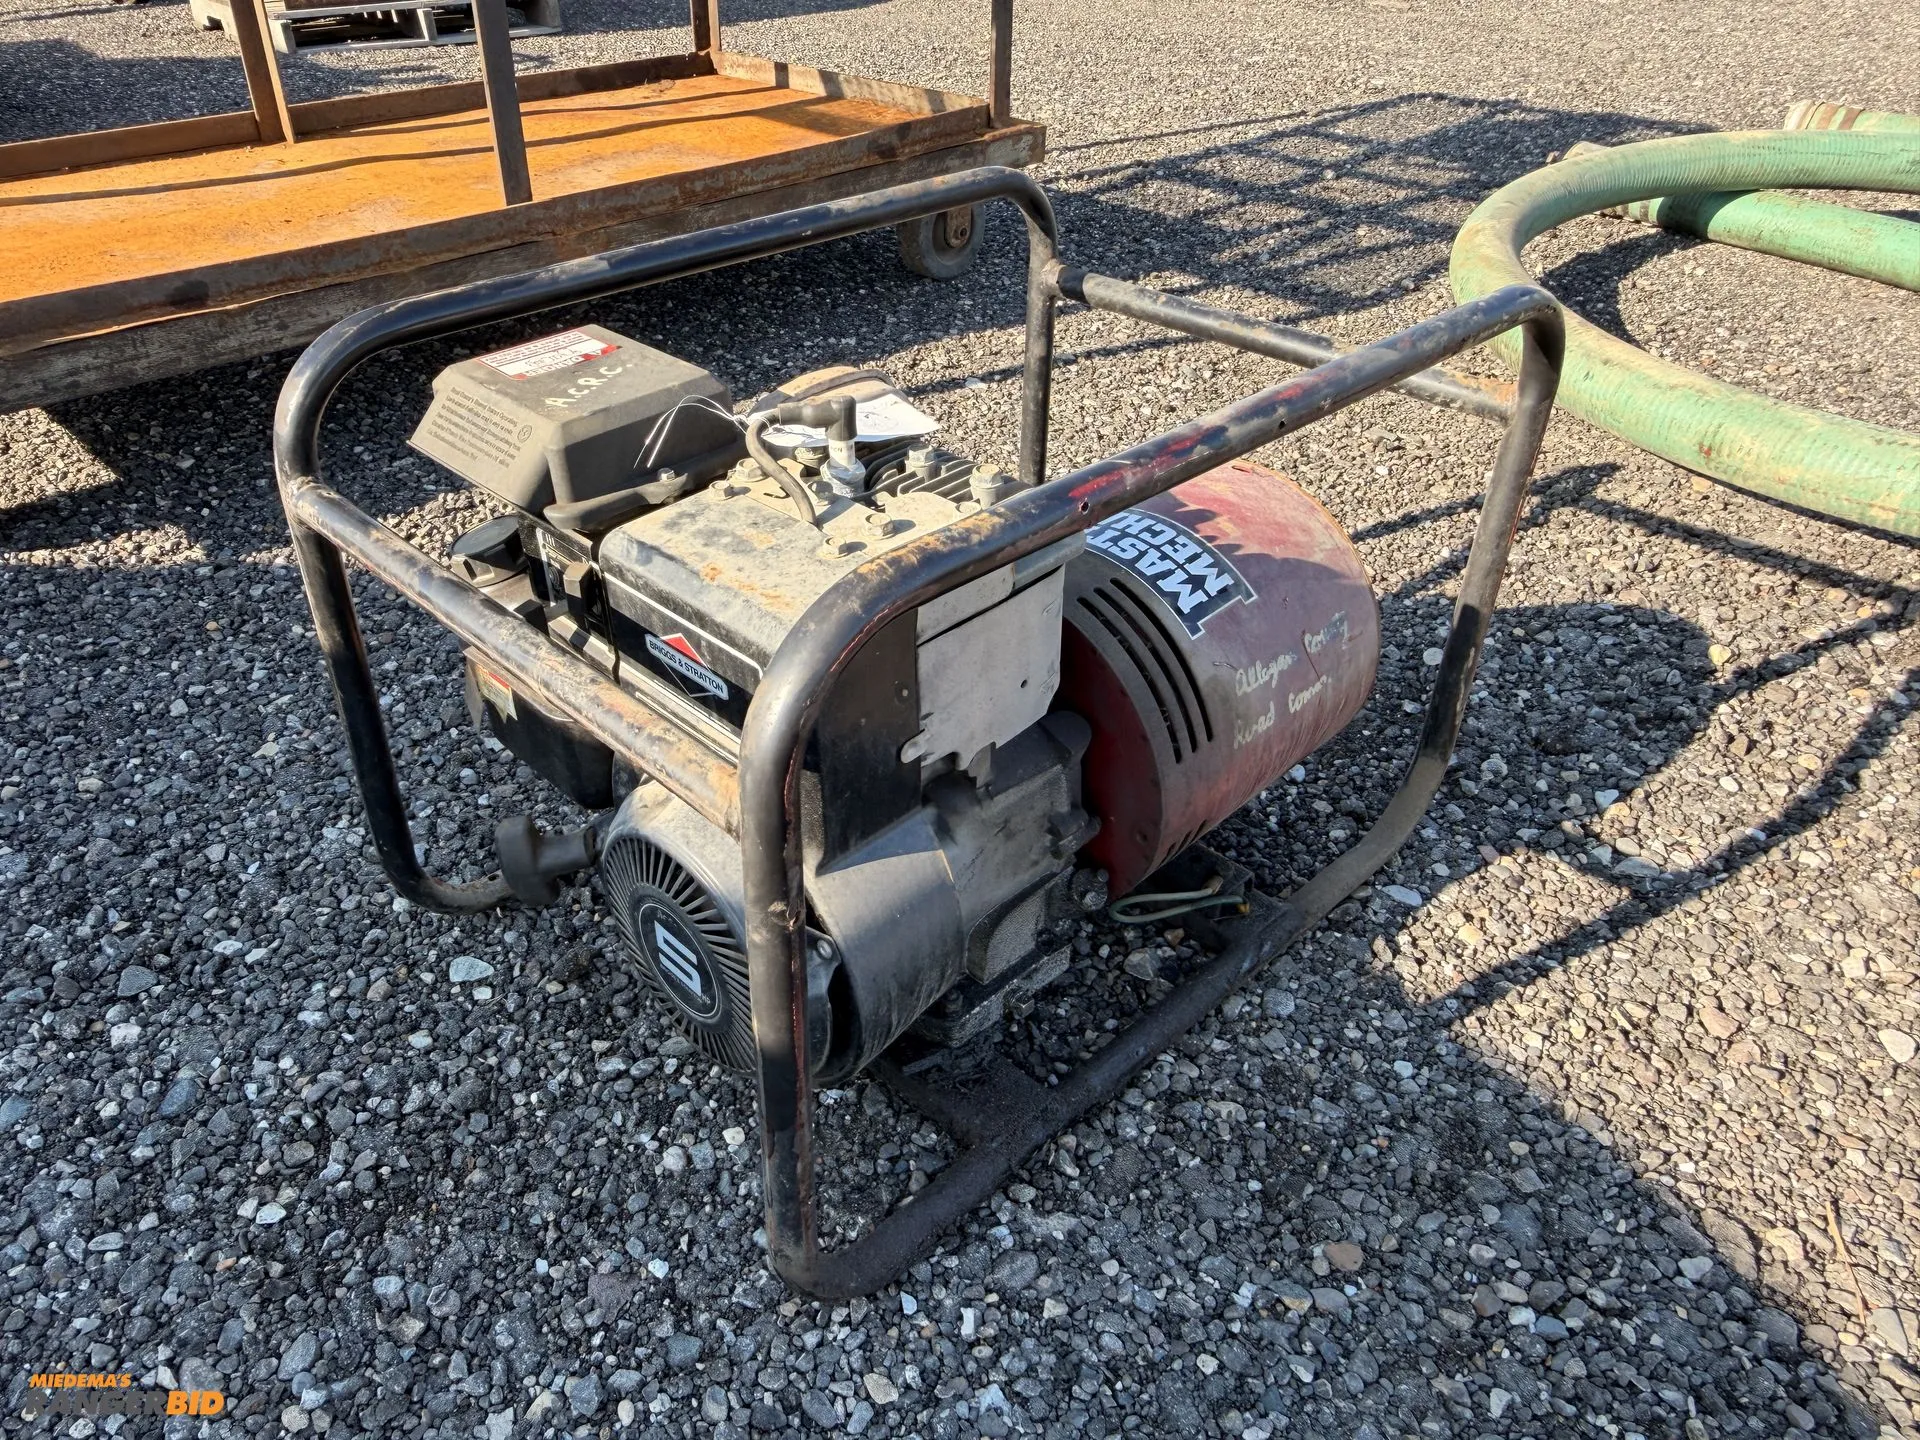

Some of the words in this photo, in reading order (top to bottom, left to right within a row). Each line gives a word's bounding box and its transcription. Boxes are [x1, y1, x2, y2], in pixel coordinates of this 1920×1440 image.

[1086, 528, 1209, 615] MAST
[648, 639, 678, 664] BRIGGS
[684, 662, 724, 694] STRATTON
